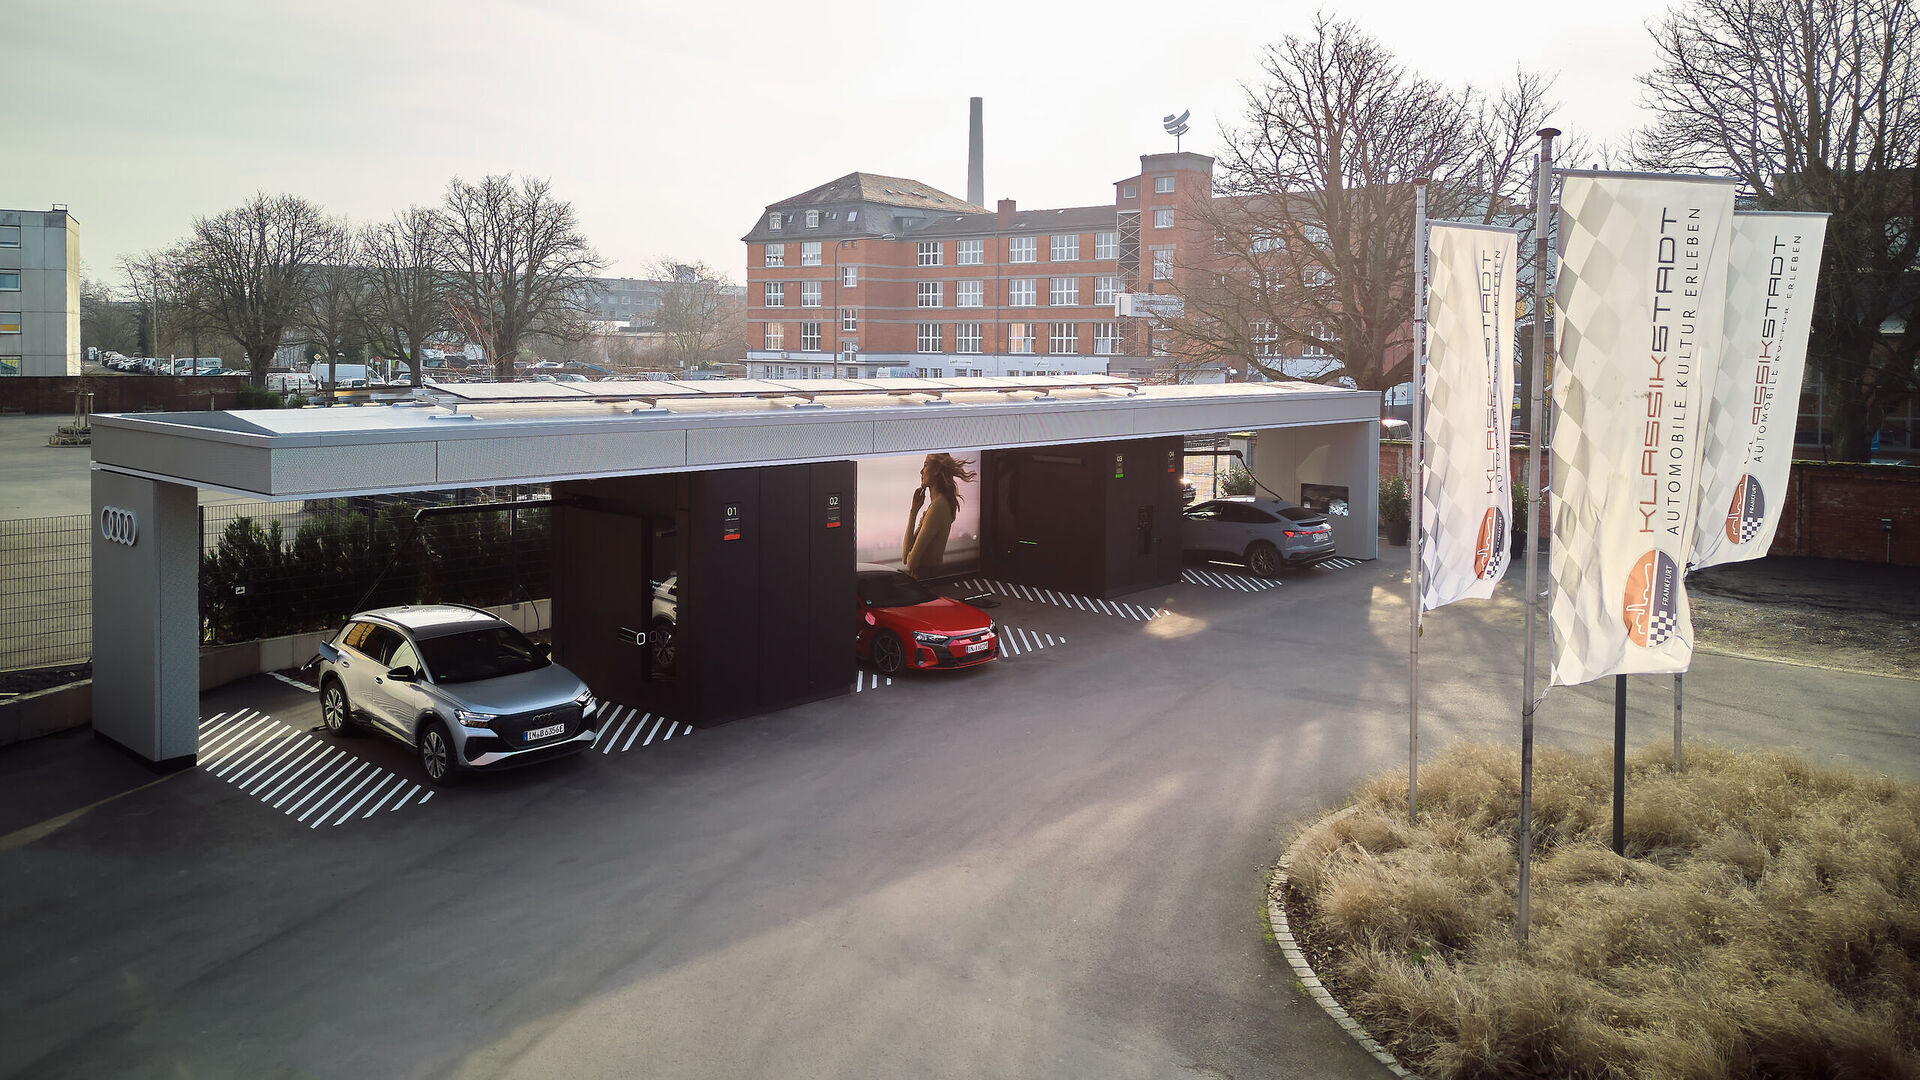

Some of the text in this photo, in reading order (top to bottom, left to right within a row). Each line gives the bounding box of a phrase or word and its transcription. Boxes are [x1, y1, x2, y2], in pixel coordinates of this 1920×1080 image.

[1639, 207, 1678, 533] KLASSIKSTADT
[1666, 207, 1701, 536] AUTOMOBILE KULTUR ERLEBEN
[1744, 235, 1786, 464] ASSIKSTADT
[1753, 370, 1779, 463] AUTOMOBILE
[1786, 235, 1802, 299] ERLEBEN
[727, 507, 737, 516] 01
[829, 496, 839, 505] 02
[1662, 564, 1674, 607] FRANKFURT
